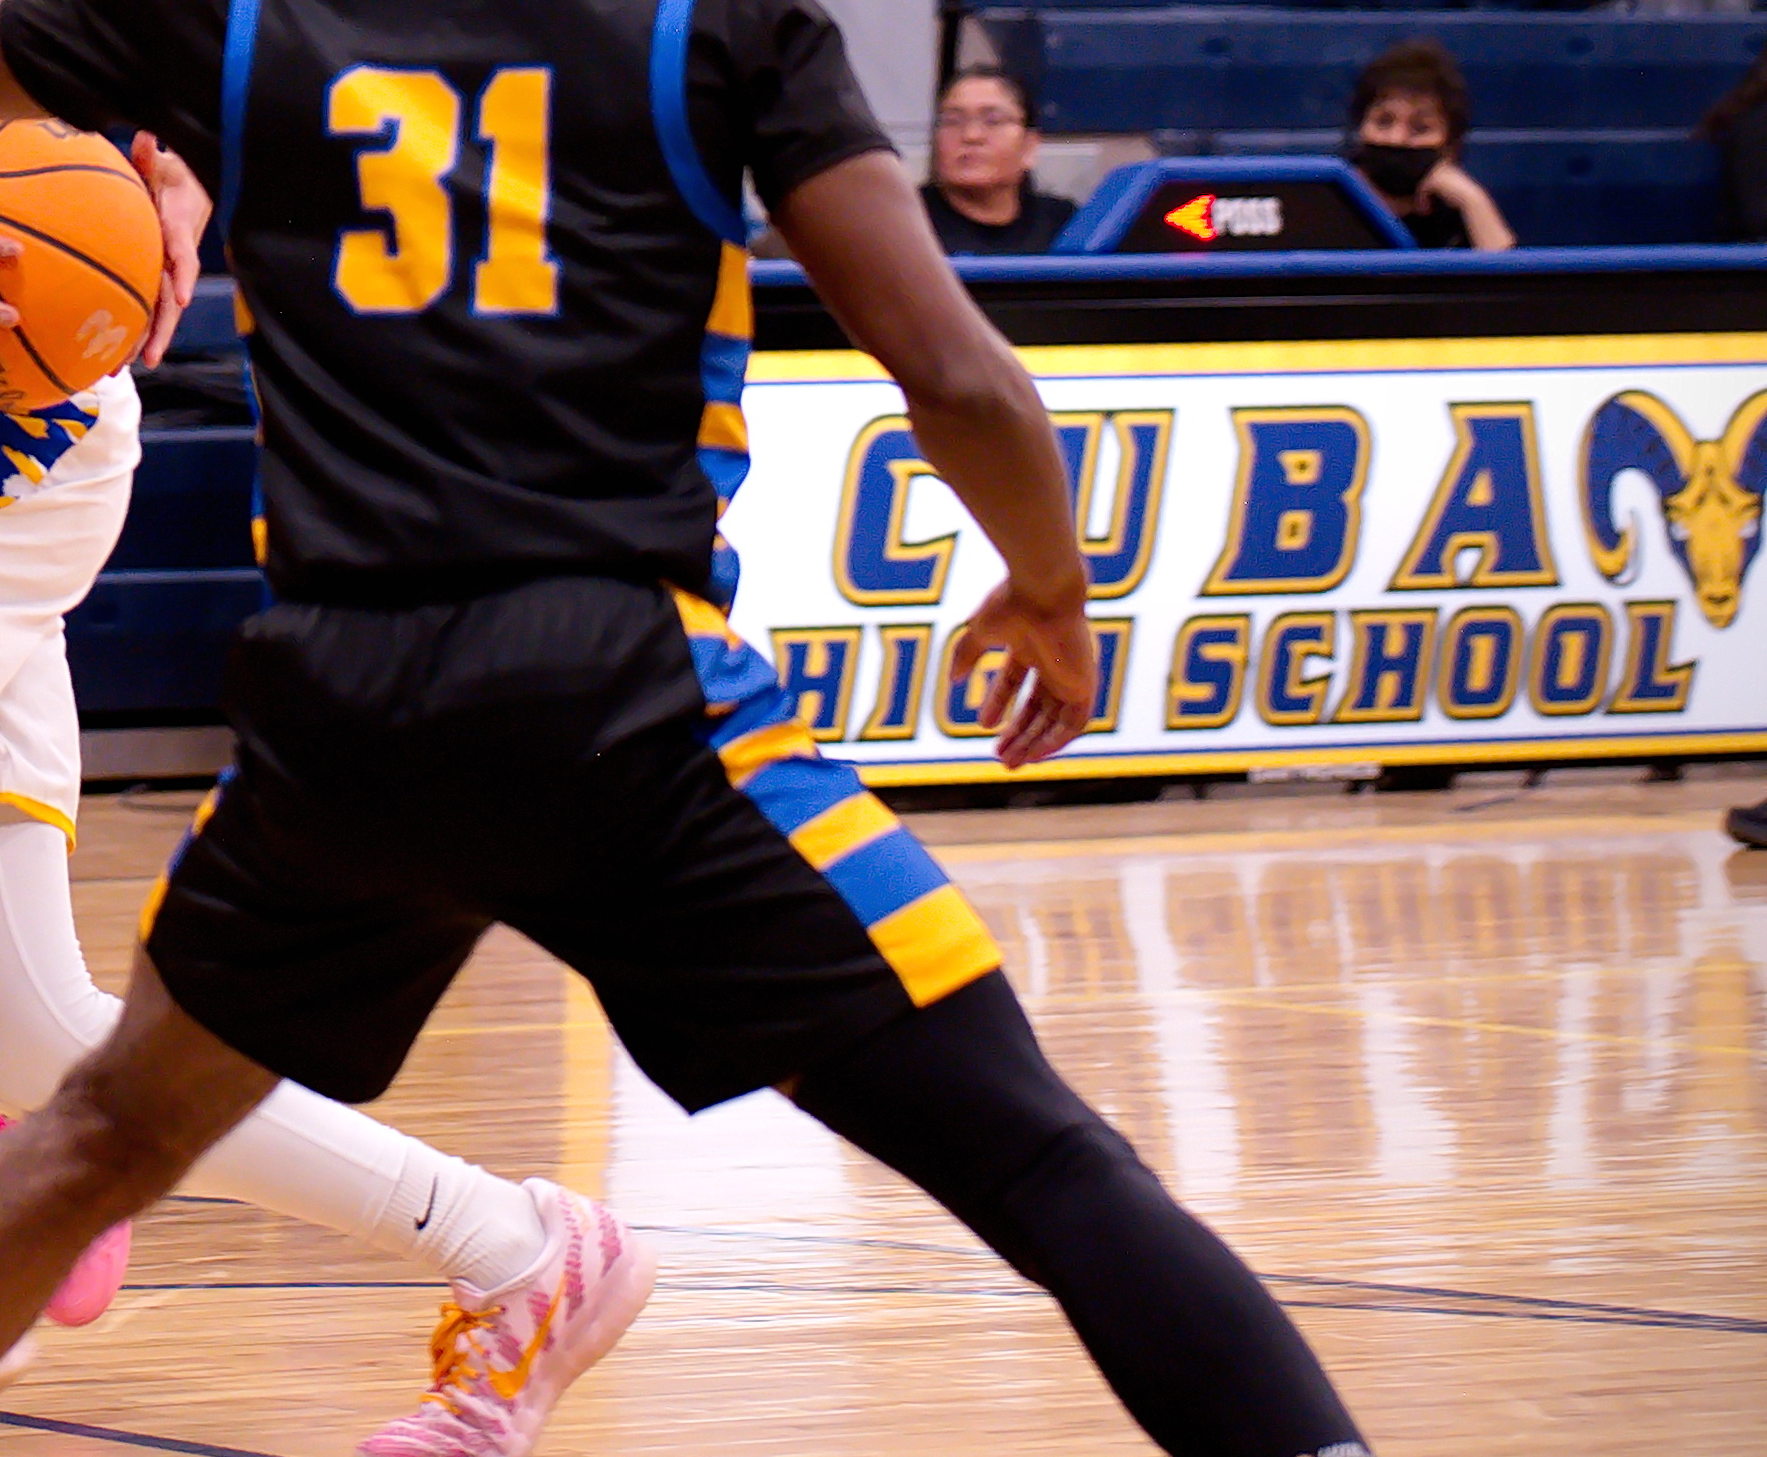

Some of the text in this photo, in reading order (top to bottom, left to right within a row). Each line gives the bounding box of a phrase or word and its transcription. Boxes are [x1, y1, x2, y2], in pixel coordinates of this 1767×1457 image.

[323, 63, 564, 317] 31
[833, 401, 1560, 607] CUBA
[1163, 600, 1698, 730] SCHOOL
